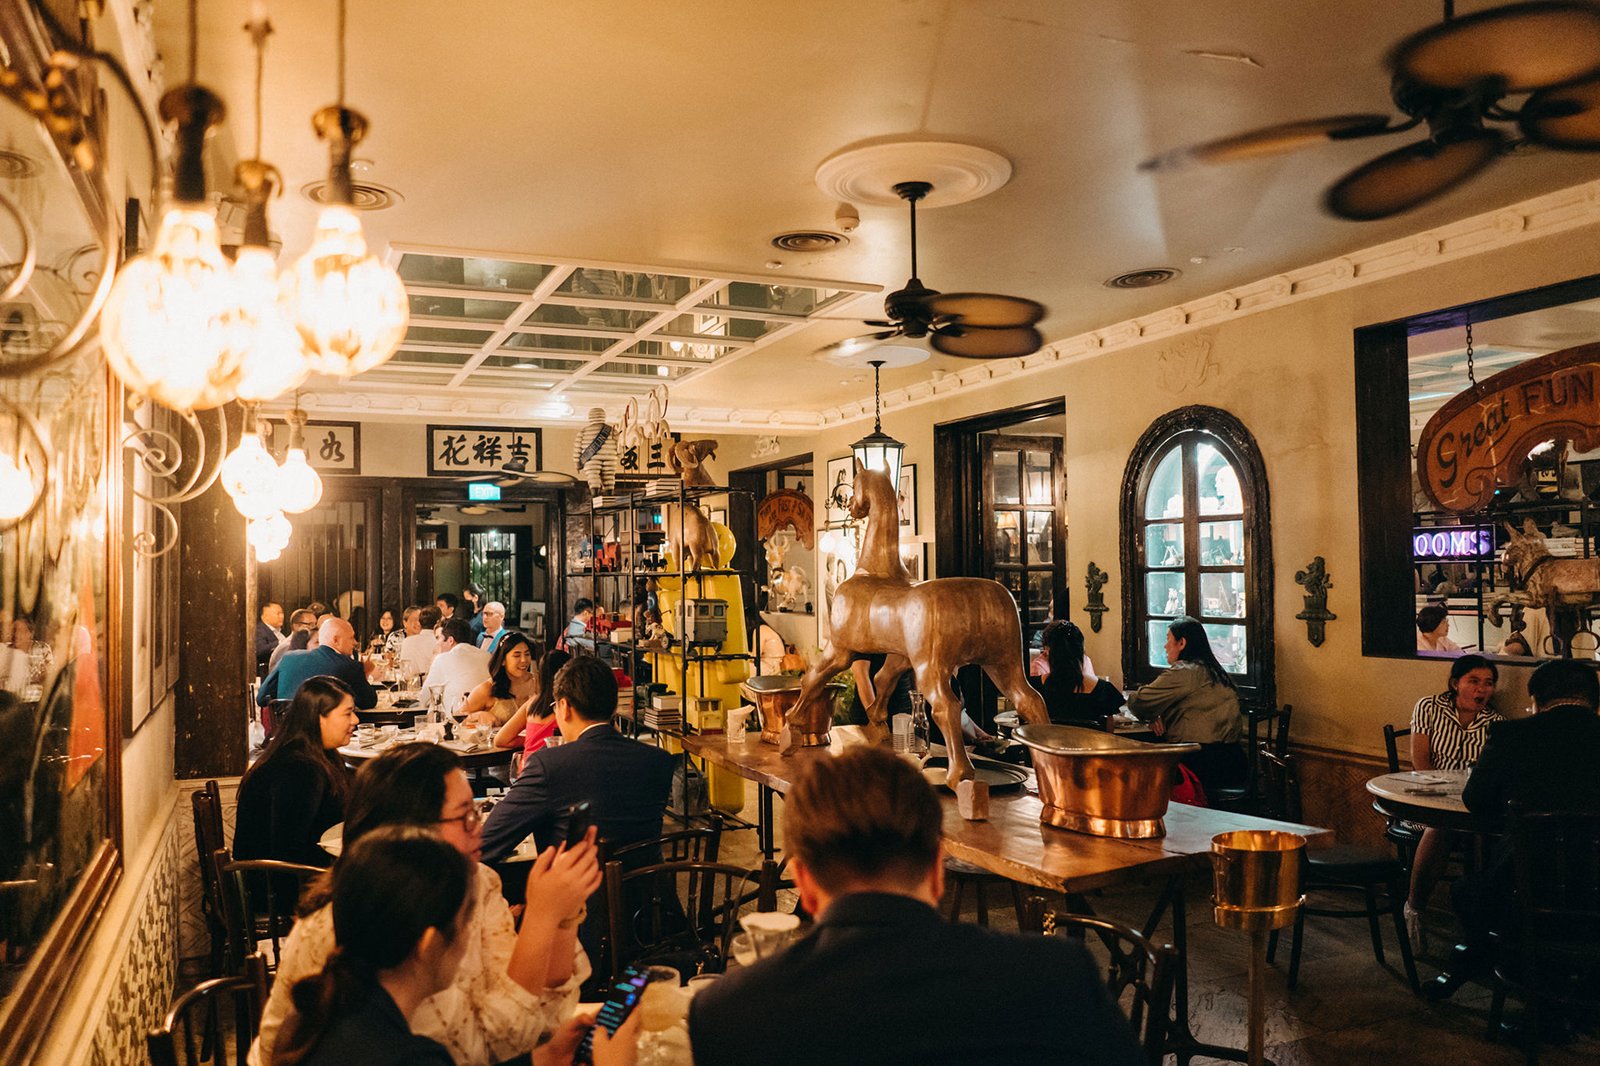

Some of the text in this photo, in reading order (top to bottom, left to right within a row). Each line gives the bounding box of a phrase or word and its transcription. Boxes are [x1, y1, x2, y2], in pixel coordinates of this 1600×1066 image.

[1437, 369, 1595, 489] Great FUN
[1413, 531, 1491, 557] OOMS
